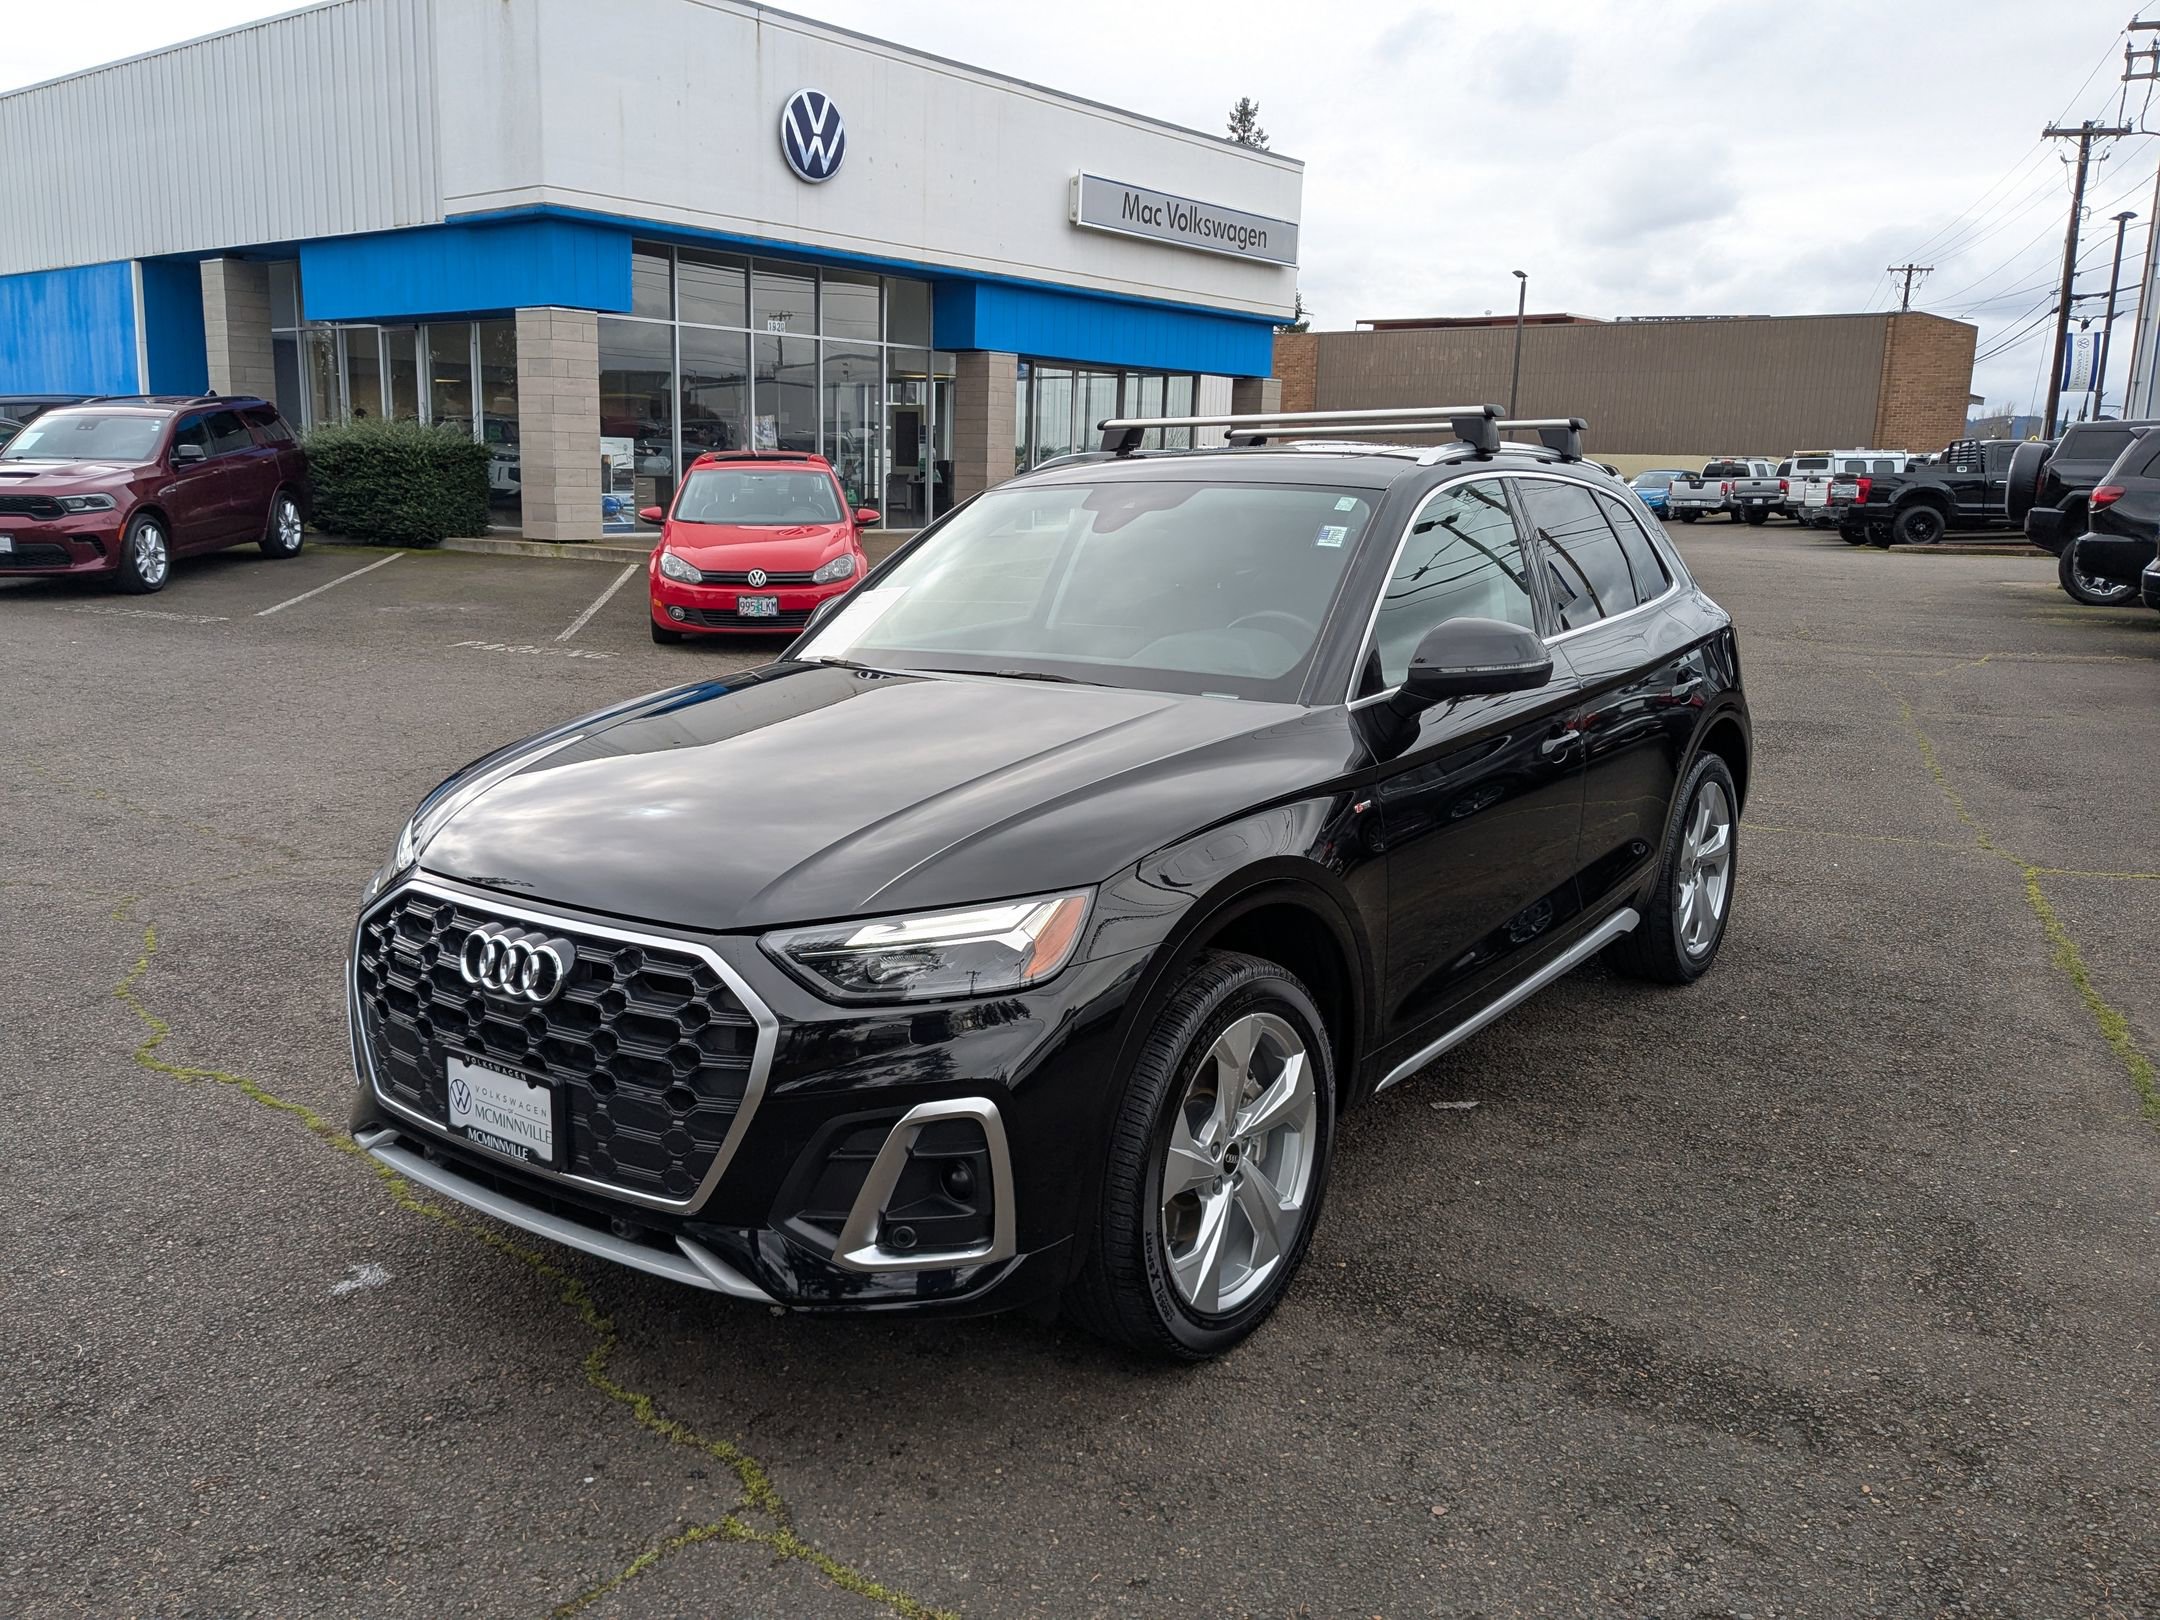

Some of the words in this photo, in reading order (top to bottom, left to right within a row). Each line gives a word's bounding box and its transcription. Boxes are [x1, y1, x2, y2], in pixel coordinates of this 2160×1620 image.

[1121, 191, 1162, 227] Mac
[1166, 201, 1268, 250] Volkswagen
[465, 1055, 527, 1080] VOLKSWAGEN
[475, 1085, 548, 1118] VOLKSWAGEN
[475, 1104, 552, 1145] MCMINNVILLE
[467, 1128, 529, 1160] MCMINNVILLE
[1145, 1231, 1156, 1270] SPORT
